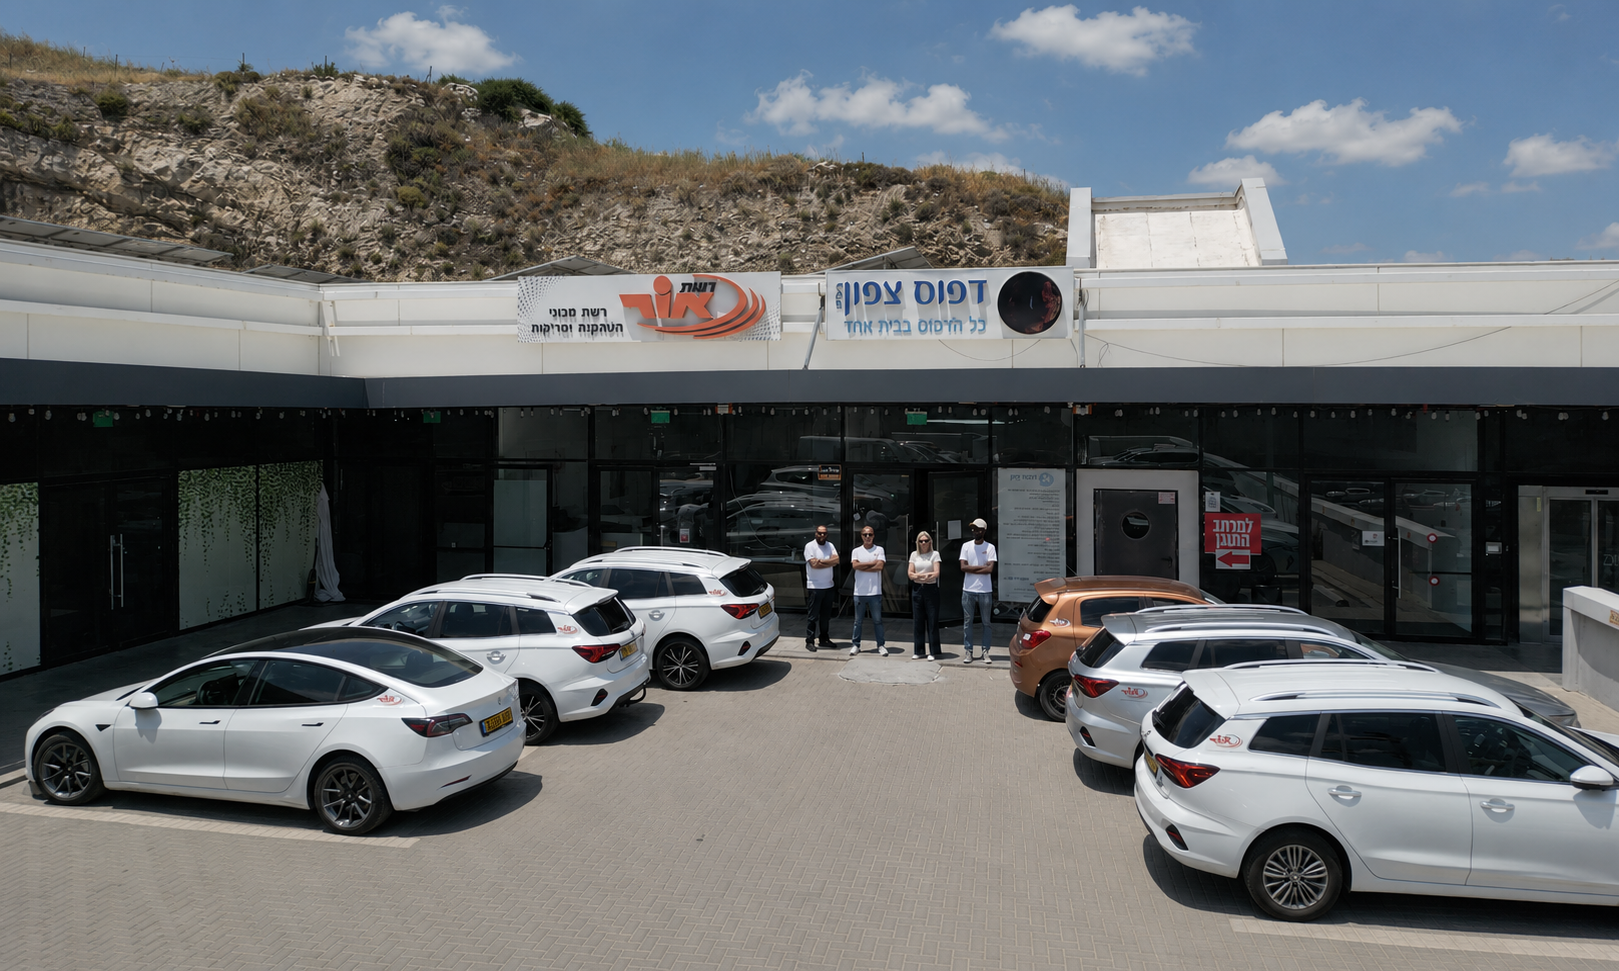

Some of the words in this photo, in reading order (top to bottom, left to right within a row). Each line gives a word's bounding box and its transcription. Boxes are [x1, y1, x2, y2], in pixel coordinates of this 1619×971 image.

[844, 280, 903, 317] צפון
[913, 279, 988, 305] דפוס
[549, 307, 577, 318] מכוני
[581, 307, 608, 318] רשת
[843, 320, 874, 334] אחד
[878, 319, 912, 333] בבית
[969, 315, 986, 333] כל
